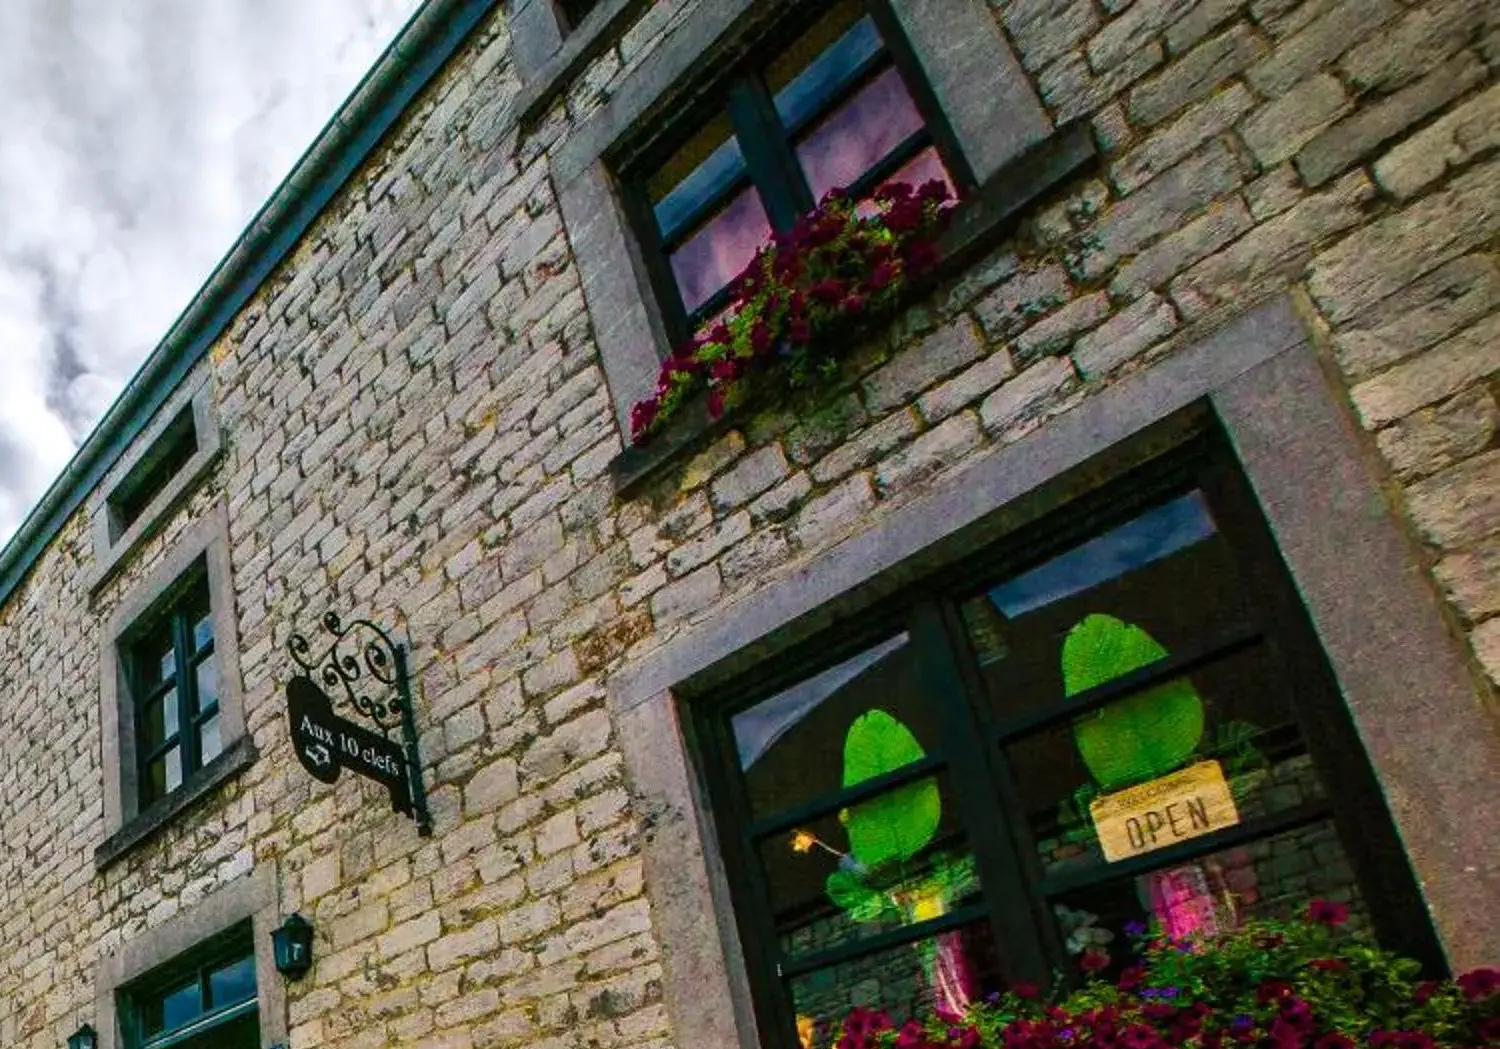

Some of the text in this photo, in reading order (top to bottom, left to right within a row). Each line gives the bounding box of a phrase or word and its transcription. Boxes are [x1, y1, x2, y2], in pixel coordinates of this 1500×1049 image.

[300, 714, 400, 777] Aux 10 clefs
[1125, 796, 1210, 849] OPEN
